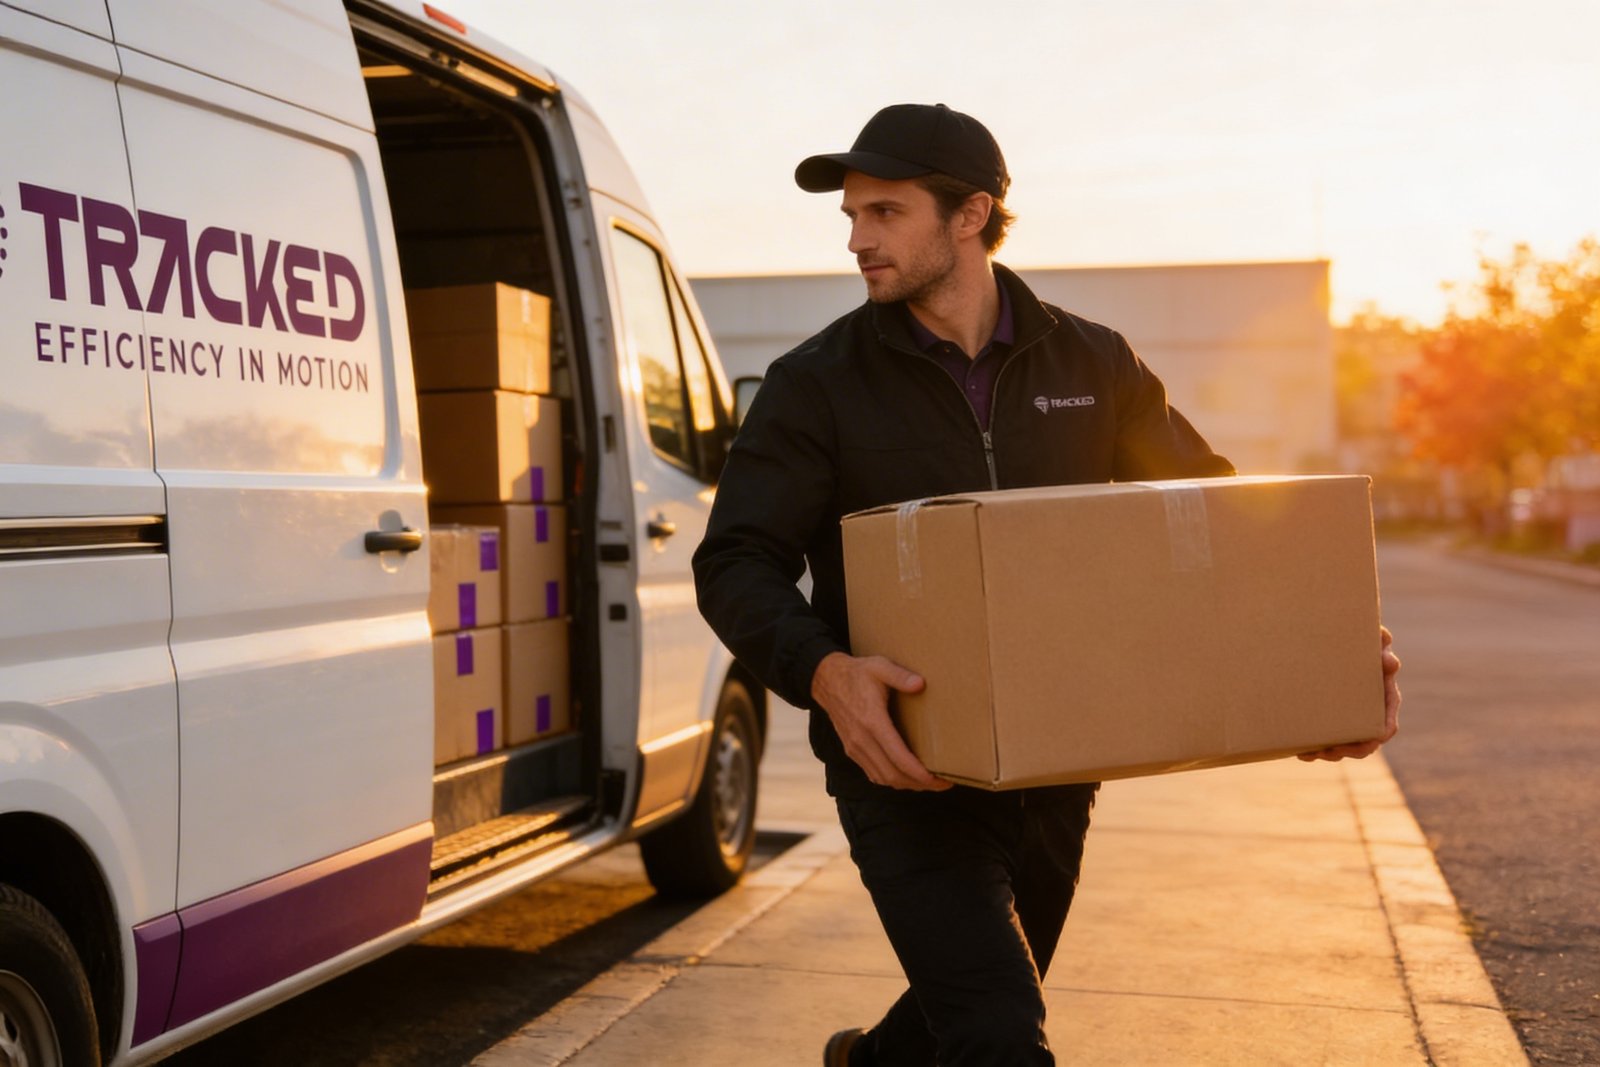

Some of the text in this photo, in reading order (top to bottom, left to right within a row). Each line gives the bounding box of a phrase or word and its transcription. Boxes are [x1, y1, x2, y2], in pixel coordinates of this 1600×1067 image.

[19, 182, 365, 342] TRACKED
[35, 322, 368, 393] EFFICIENCY IN MOTION
